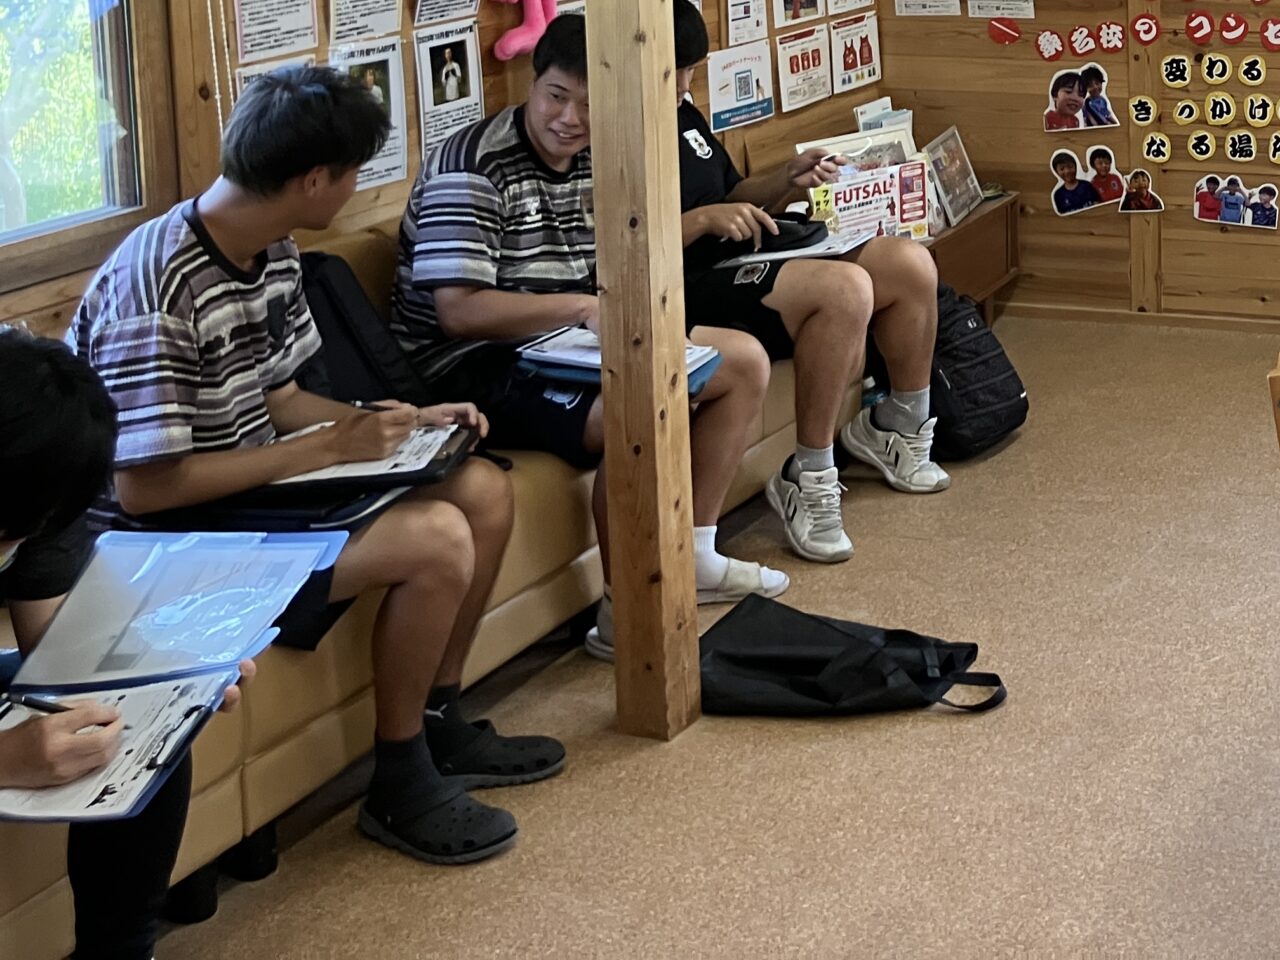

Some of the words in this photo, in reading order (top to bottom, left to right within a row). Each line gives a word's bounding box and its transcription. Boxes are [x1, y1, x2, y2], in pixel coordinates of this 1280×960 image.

[1164, 57, 1261, 82] 変わる
[834, 181, 891, 207] FUTSAL
